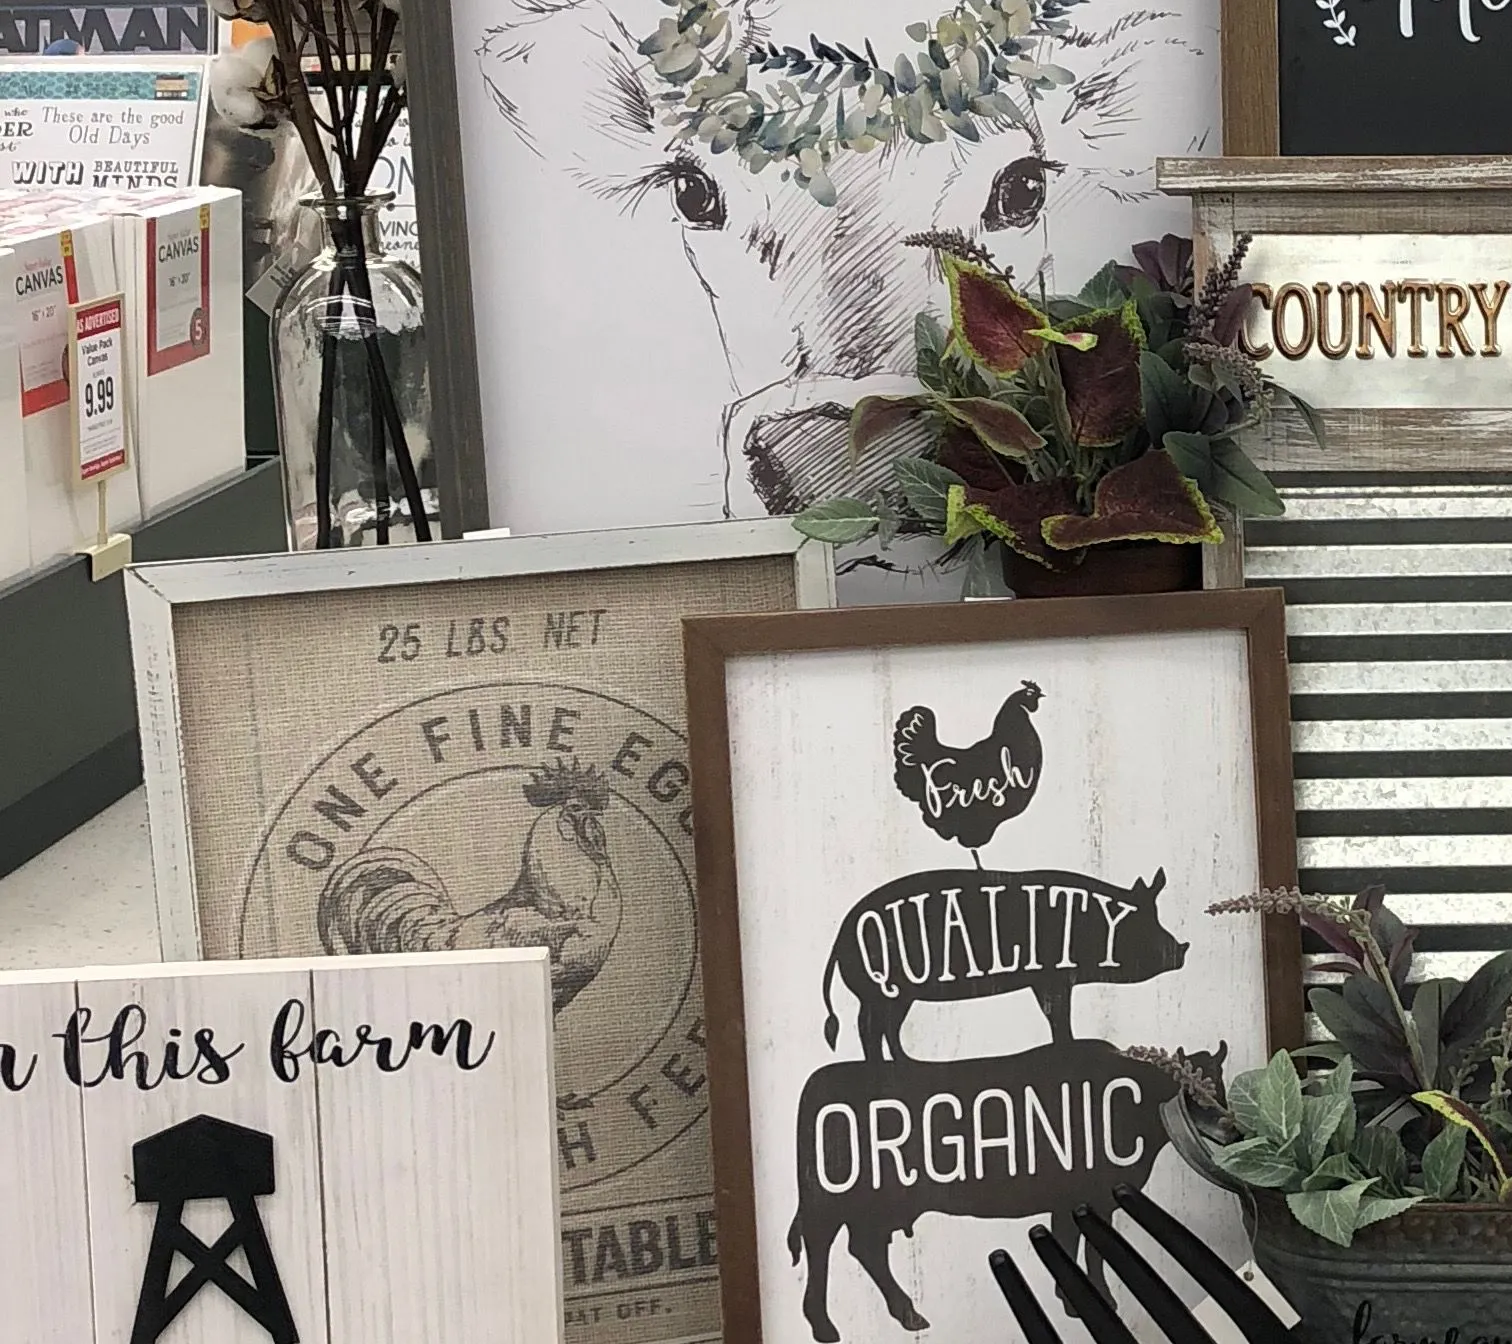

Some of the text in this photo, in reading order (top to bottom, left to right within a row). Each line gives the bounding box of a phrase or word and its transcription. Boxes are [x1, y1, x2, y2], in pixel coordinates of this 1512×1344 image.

[0, 121, 34, 137] ER
[42, 106, 185, 129] These are the good
[69, 125, 151, 149] Old Days
[11, 160, 84, 185] WITH
[93, 160, 179, 174] BEAUTIFUL
[158, 236, 200, 263] CANVAS
[15, 265, 65, 296] CANVAS
[1236, 278, 1512, 360] COUNTRY
[81, 341, 98, 356] Value
[87, 351, 109, 367] Canvas
[85, 376, 115, 418] 9.99
[378, 609, 609, 663] 25 LBS NET
[286, 750, 400, 872] ONE
[422, 703, 586, 764] FINE
[921, 746, 1035, 820] Fresh
[855, 884, 1138, 999] QUALITY
[52, 998, 244, 1091] this
[270, 998, 495, 1083] farm
[815, 1077, 1145, 1194] ORGANIC
